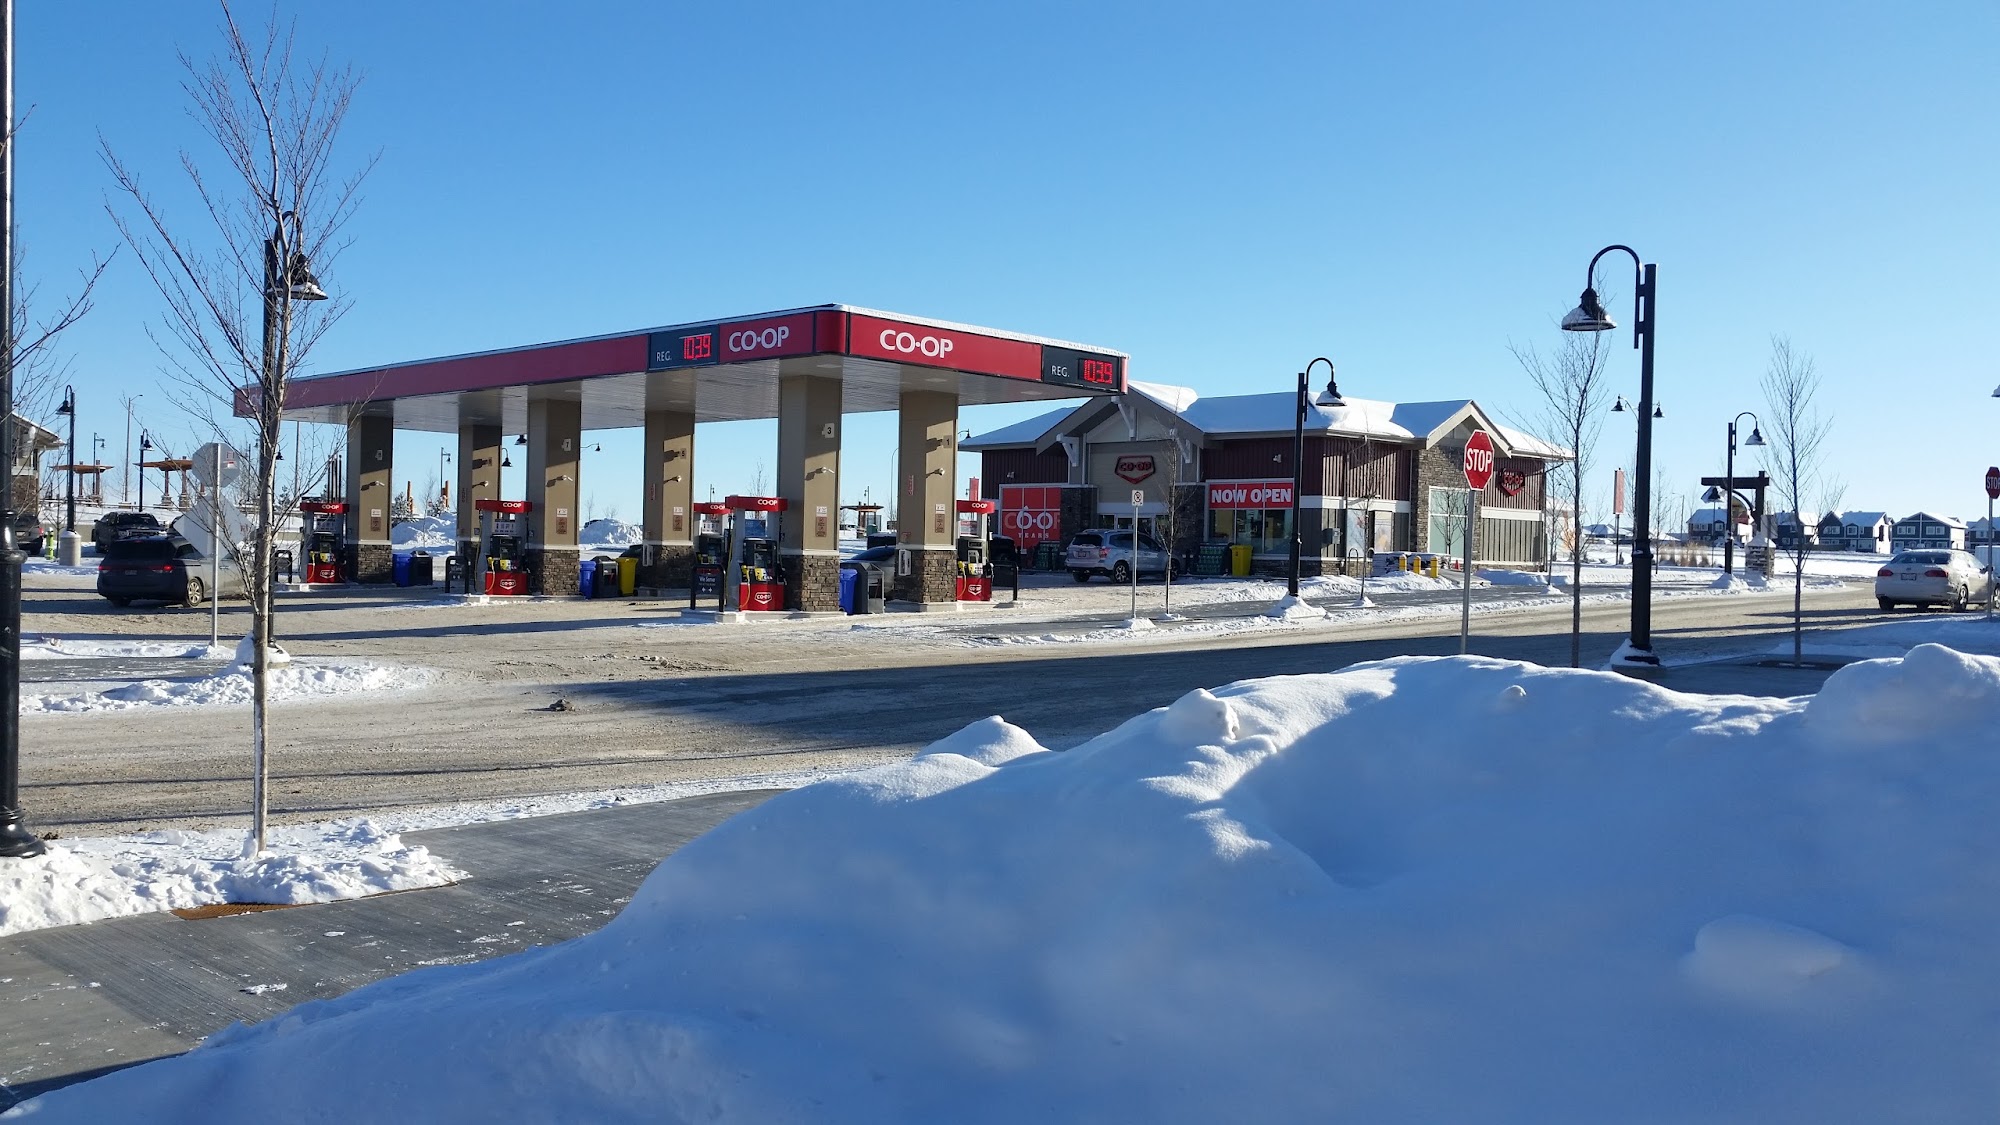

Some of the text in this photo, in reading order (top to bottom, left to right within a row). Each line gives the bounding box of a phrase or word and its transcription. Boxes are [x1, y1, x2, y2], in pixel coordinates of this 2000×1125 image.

[656, 351, 672, 362] REG.
[1051, 365, 1070, 378] REG.
[1466, 447, 1492, 473] STOP
[1211, 488, 1291, 503] NOW OPEN
